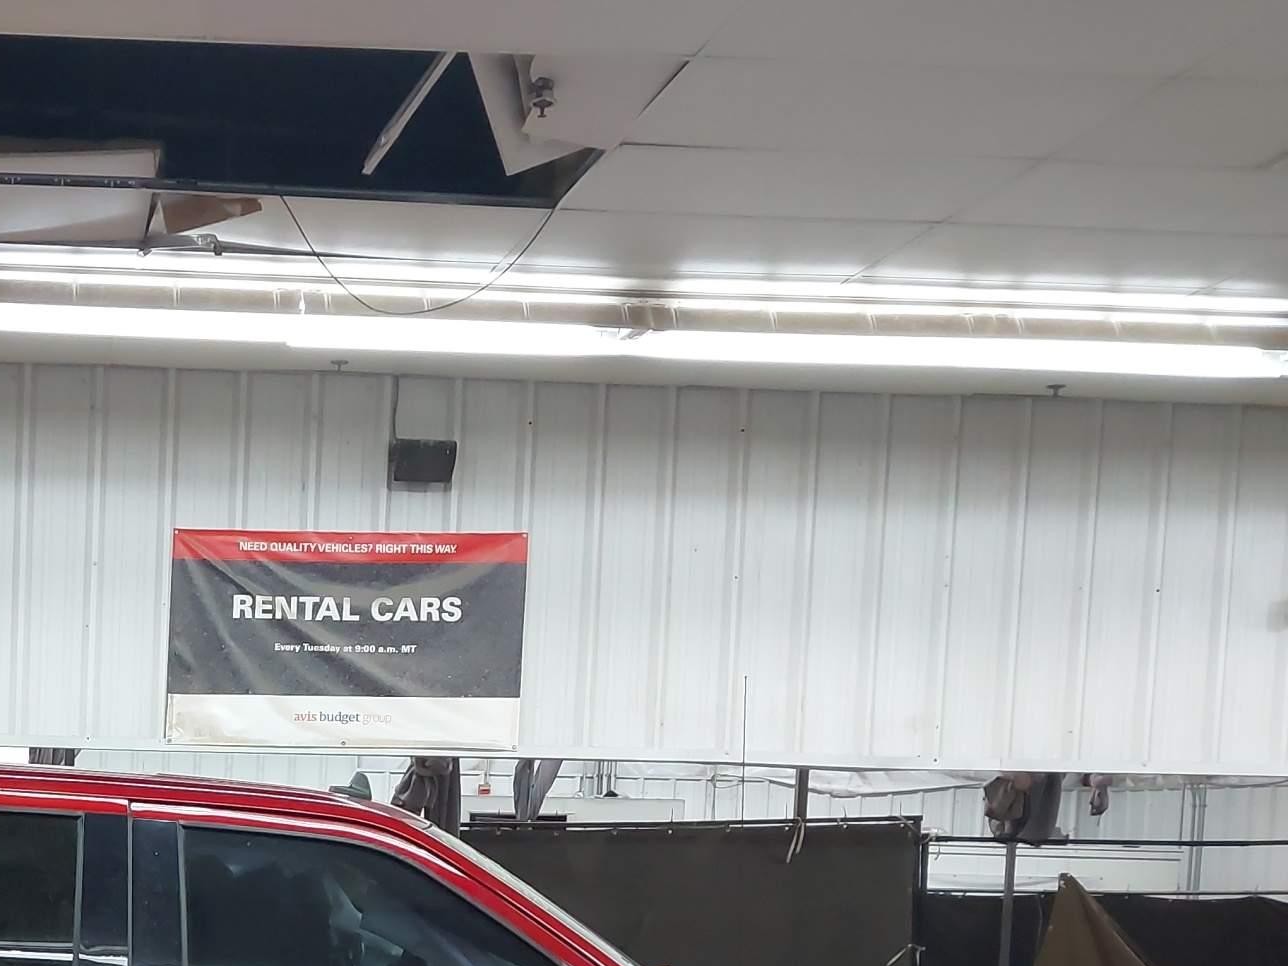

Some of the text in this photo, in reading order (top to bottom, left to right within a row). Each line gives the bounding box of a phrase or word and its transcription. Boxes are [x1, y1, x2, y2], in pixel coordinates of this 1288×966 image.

[239, 541, 268, 551] NEED
[270, 542, 316, 552] QUALITY
[318, 543, 373, 553] VEHICLES?
[375, 543, 408, 554] RIGHT
[410, 544, 433, 554] THIS
[232, 594, 462, 622] RENTAL CARS
[274, 643, 300, 653] Every
[303, 643, 340, 654] Tuesday
[343, 645, 352, 653] at
[355, 645, 376, 653] 9:00
[401, 645, 417, 653] MT
[294, 711, 317, 722] avis
[319, 711, 360, 724] budget
